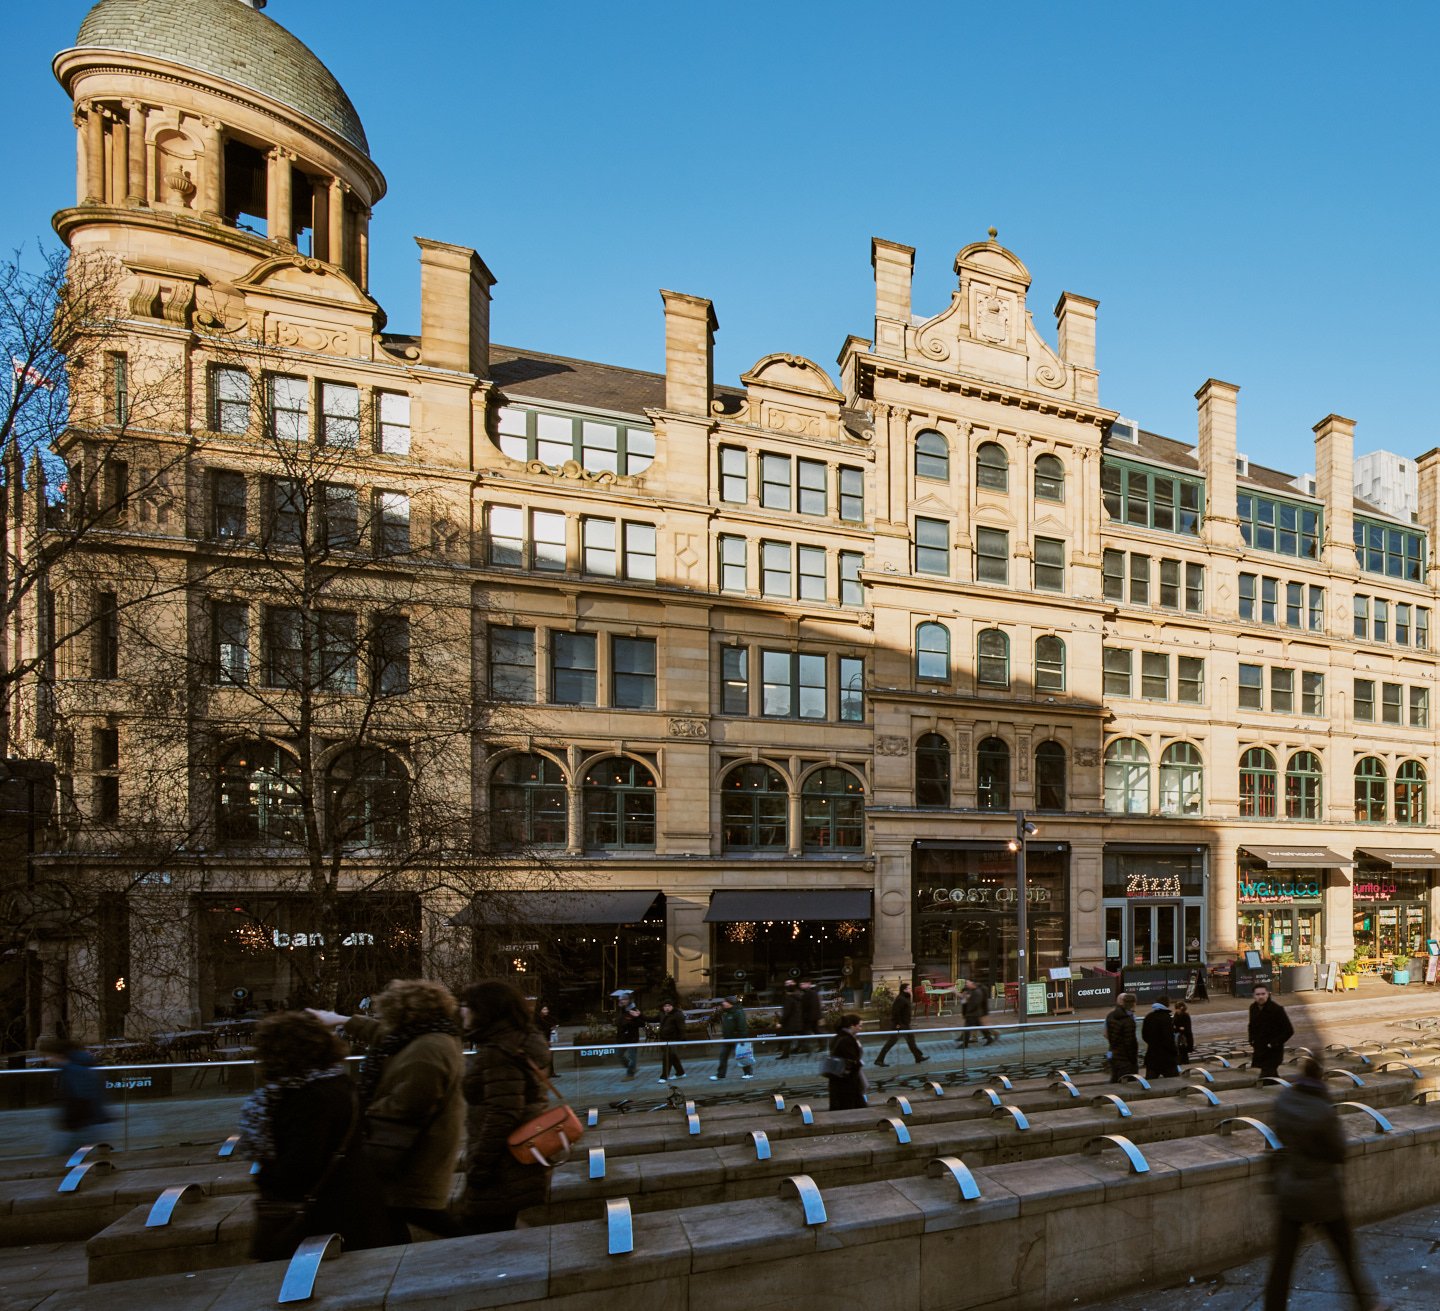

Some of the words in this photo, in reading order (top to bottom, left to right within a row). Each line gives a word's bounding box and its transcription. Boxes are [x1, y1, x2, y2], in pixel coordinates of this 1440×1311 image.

[1126, 874, 1180, 891] Zizzi
[1240, 881, 1319, 896] wahaca
[933, 887, 992, 902] COSY
[273, 929, 374, 947] banan
[580, 1048, 615, 1056] banyan
[105, 1080, 152, 1088] banyan
